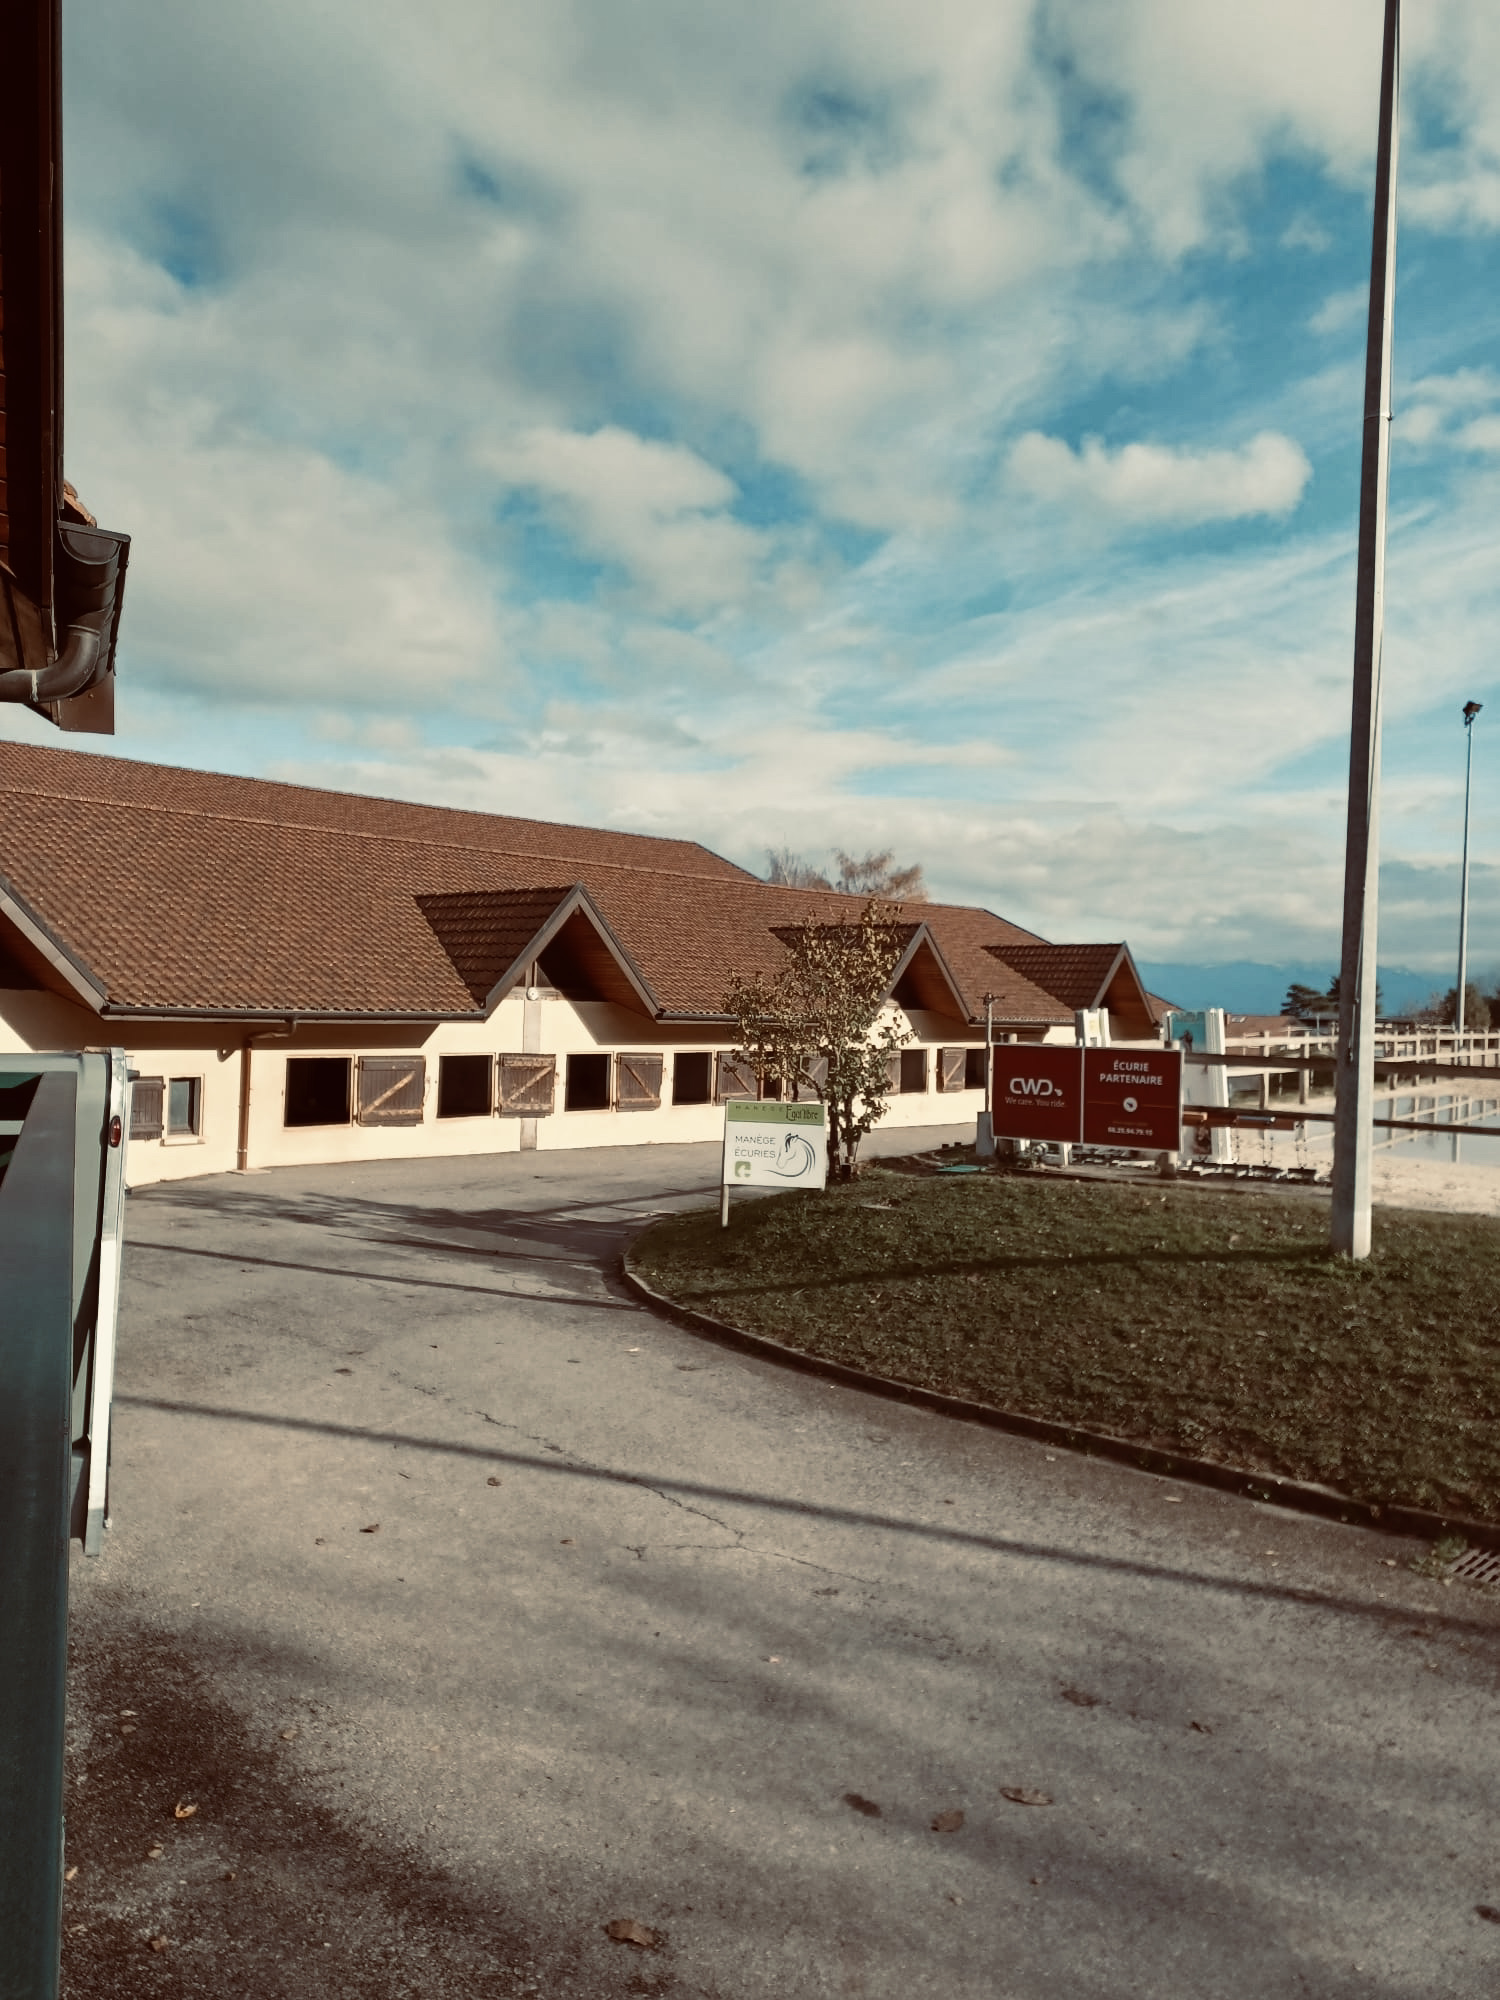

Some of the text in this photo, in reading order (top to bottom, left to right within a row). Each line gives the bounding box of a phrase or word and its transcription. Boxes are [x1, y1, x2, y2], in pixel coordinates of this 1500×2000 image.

[1113, 1059, 1150, 1072] ÉCURIE
[1009, 1077, 1053, 1095] CWD
[1099, 1073, 1164, 1086] PARTENAIRE
[734, 1147, 775, 1158] ÉCURIES
